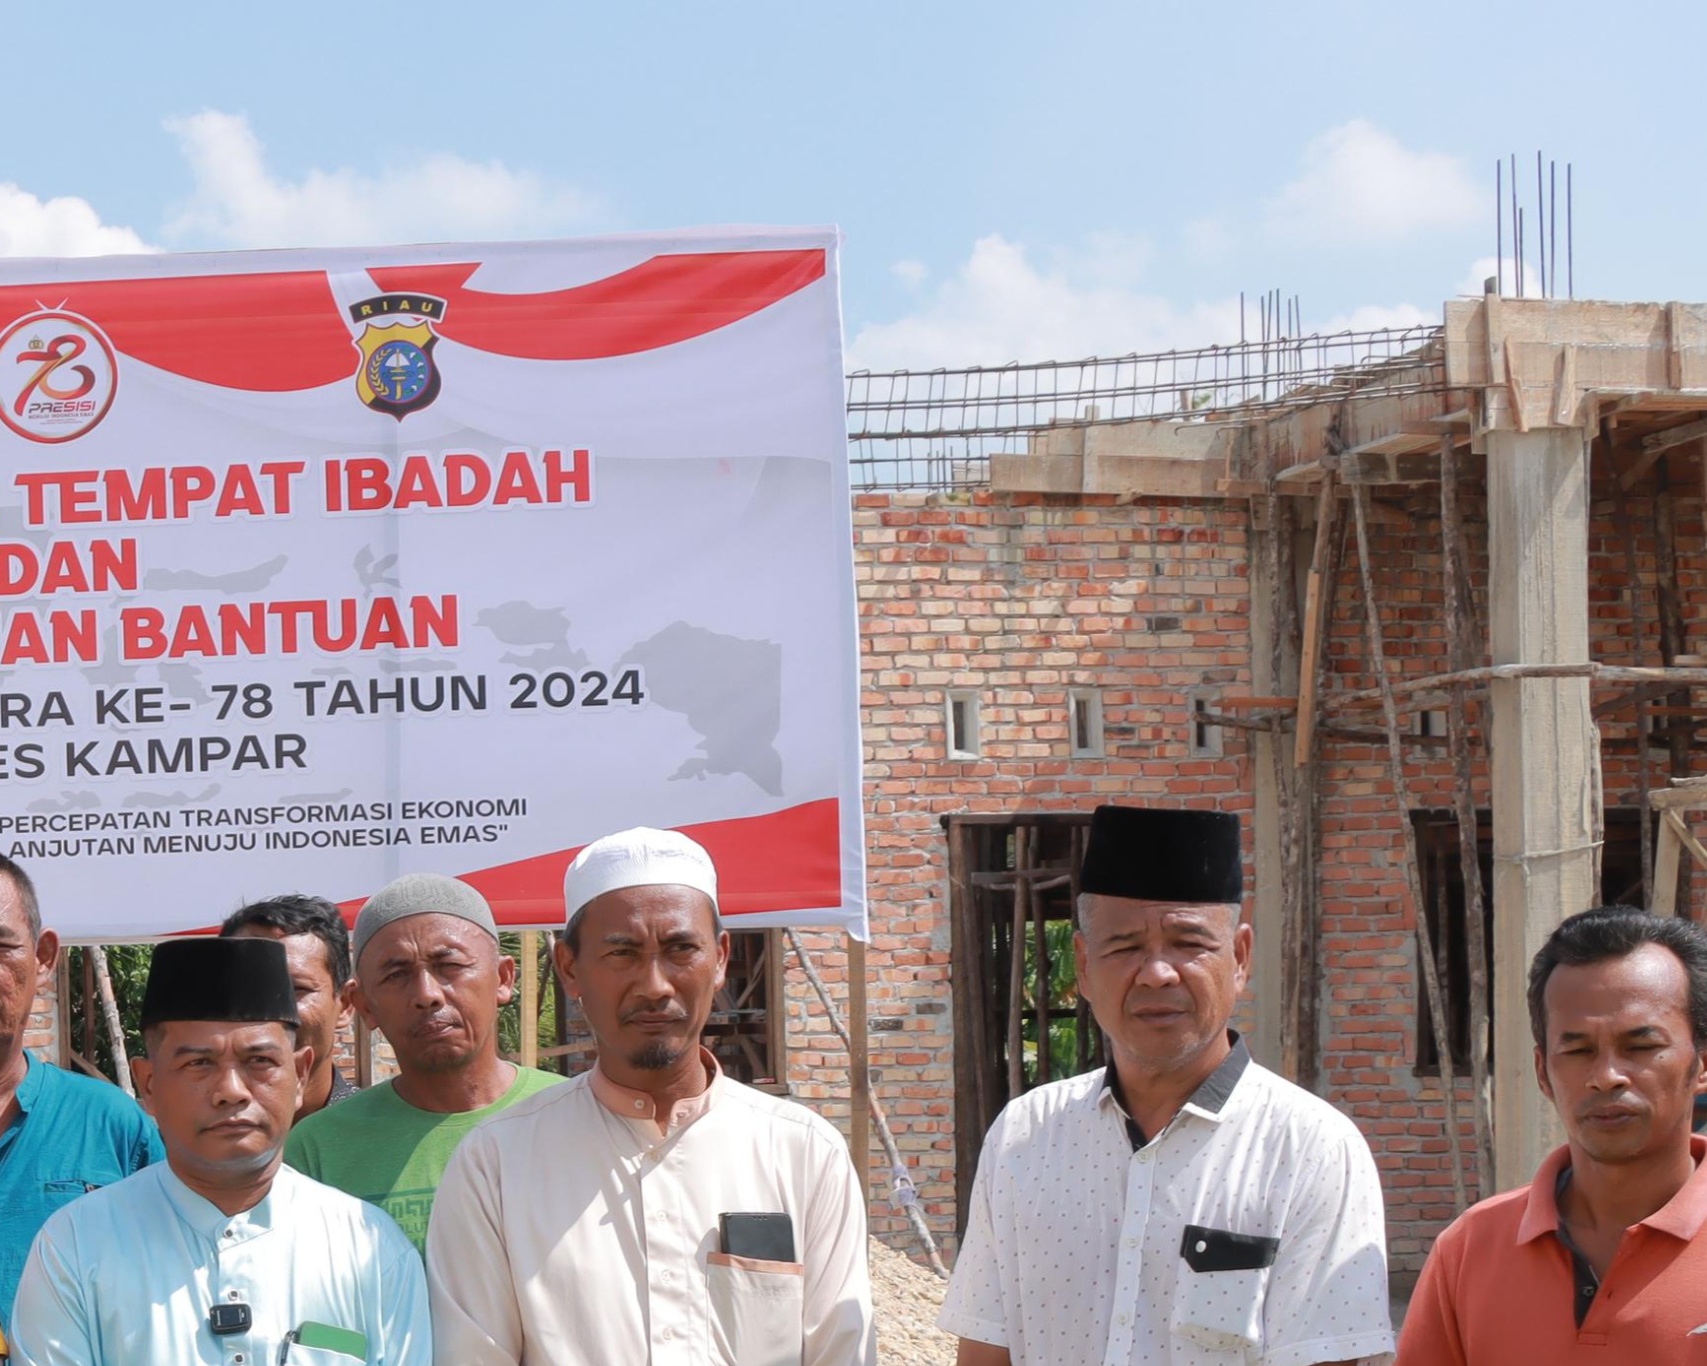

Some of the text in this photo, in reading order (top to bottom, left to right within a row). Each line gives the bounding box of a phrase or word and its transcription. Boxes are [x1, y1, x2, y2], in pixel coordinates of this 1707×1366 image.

[361, 299, 433, 316] RIAU
[28, 400, 97, 414] PRESISI
[15, 461, 304, 526] TEMPAT
[326, 449, 591, 512] IBADAH
[120, 593, 459, 660] BANTUAN
[96, 687, 191, 725] KE-
[211, 683, 273, 720] 78
[293, 675, 487, 717] TAHUN
[509, 670, 644, 709] 2024
[66, 732, 309, 777] KAMPAR
[179, 802, 393, 827] TRANSFORMASI
[401, 798, 527, 820] EKONOMI
[143, 832, 256, 854] MENUJU
[265, 827, 412, 850] INDONESIA
[420, 824, 508, 845] EMAS"
